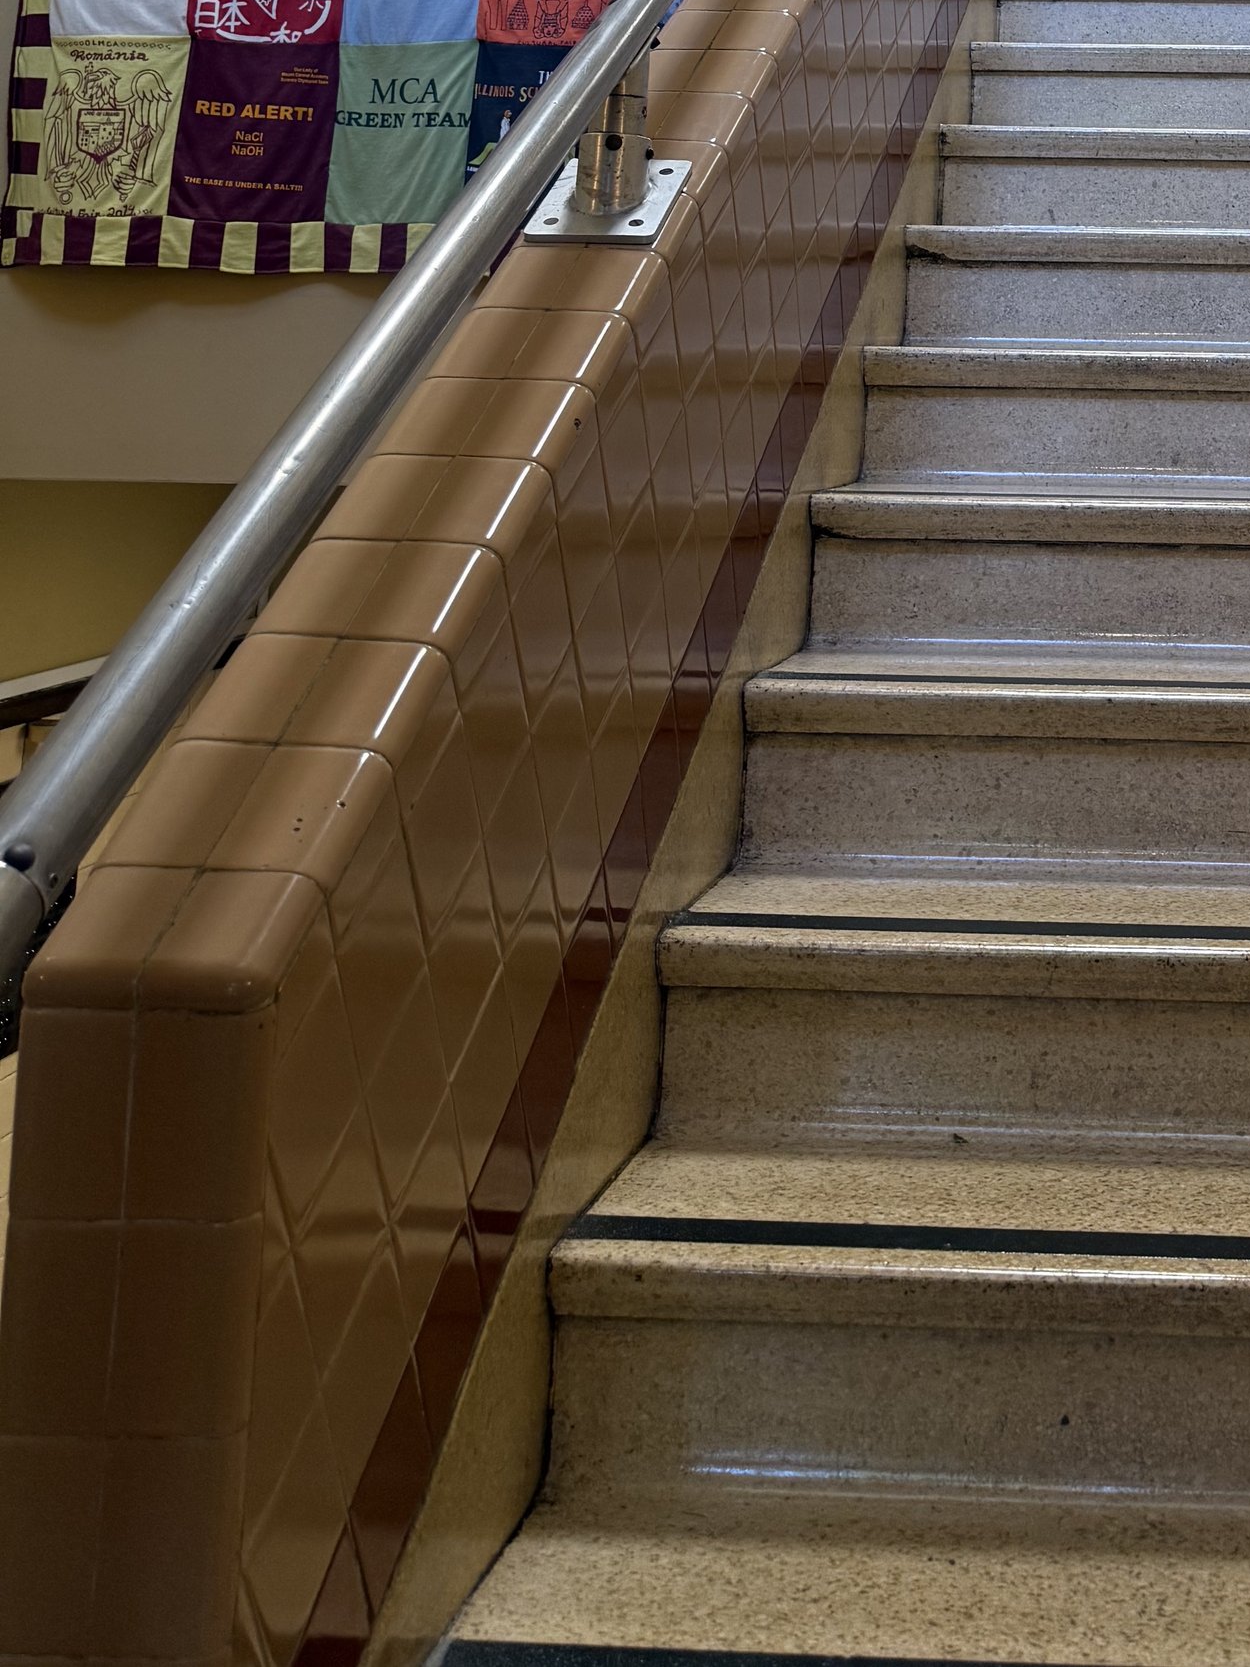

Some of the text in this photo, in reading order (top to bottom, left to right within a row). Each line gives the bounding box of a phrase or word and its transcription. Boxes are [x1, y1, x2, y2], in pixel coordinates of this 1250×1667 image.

[368, 78, 441, 105] MCA
[474, 83, 515, 99] ILLINOIS
[195, 100, 314, 121] RED ALERT!
[336, 110, 472, 128] GREEN TEAM
[235, 131, 264, 142] NaCl
[231, 145, 264, 156] NaOH
[184, 176, 202, 184] THE
[235, 181, 263, 189] UNDER
